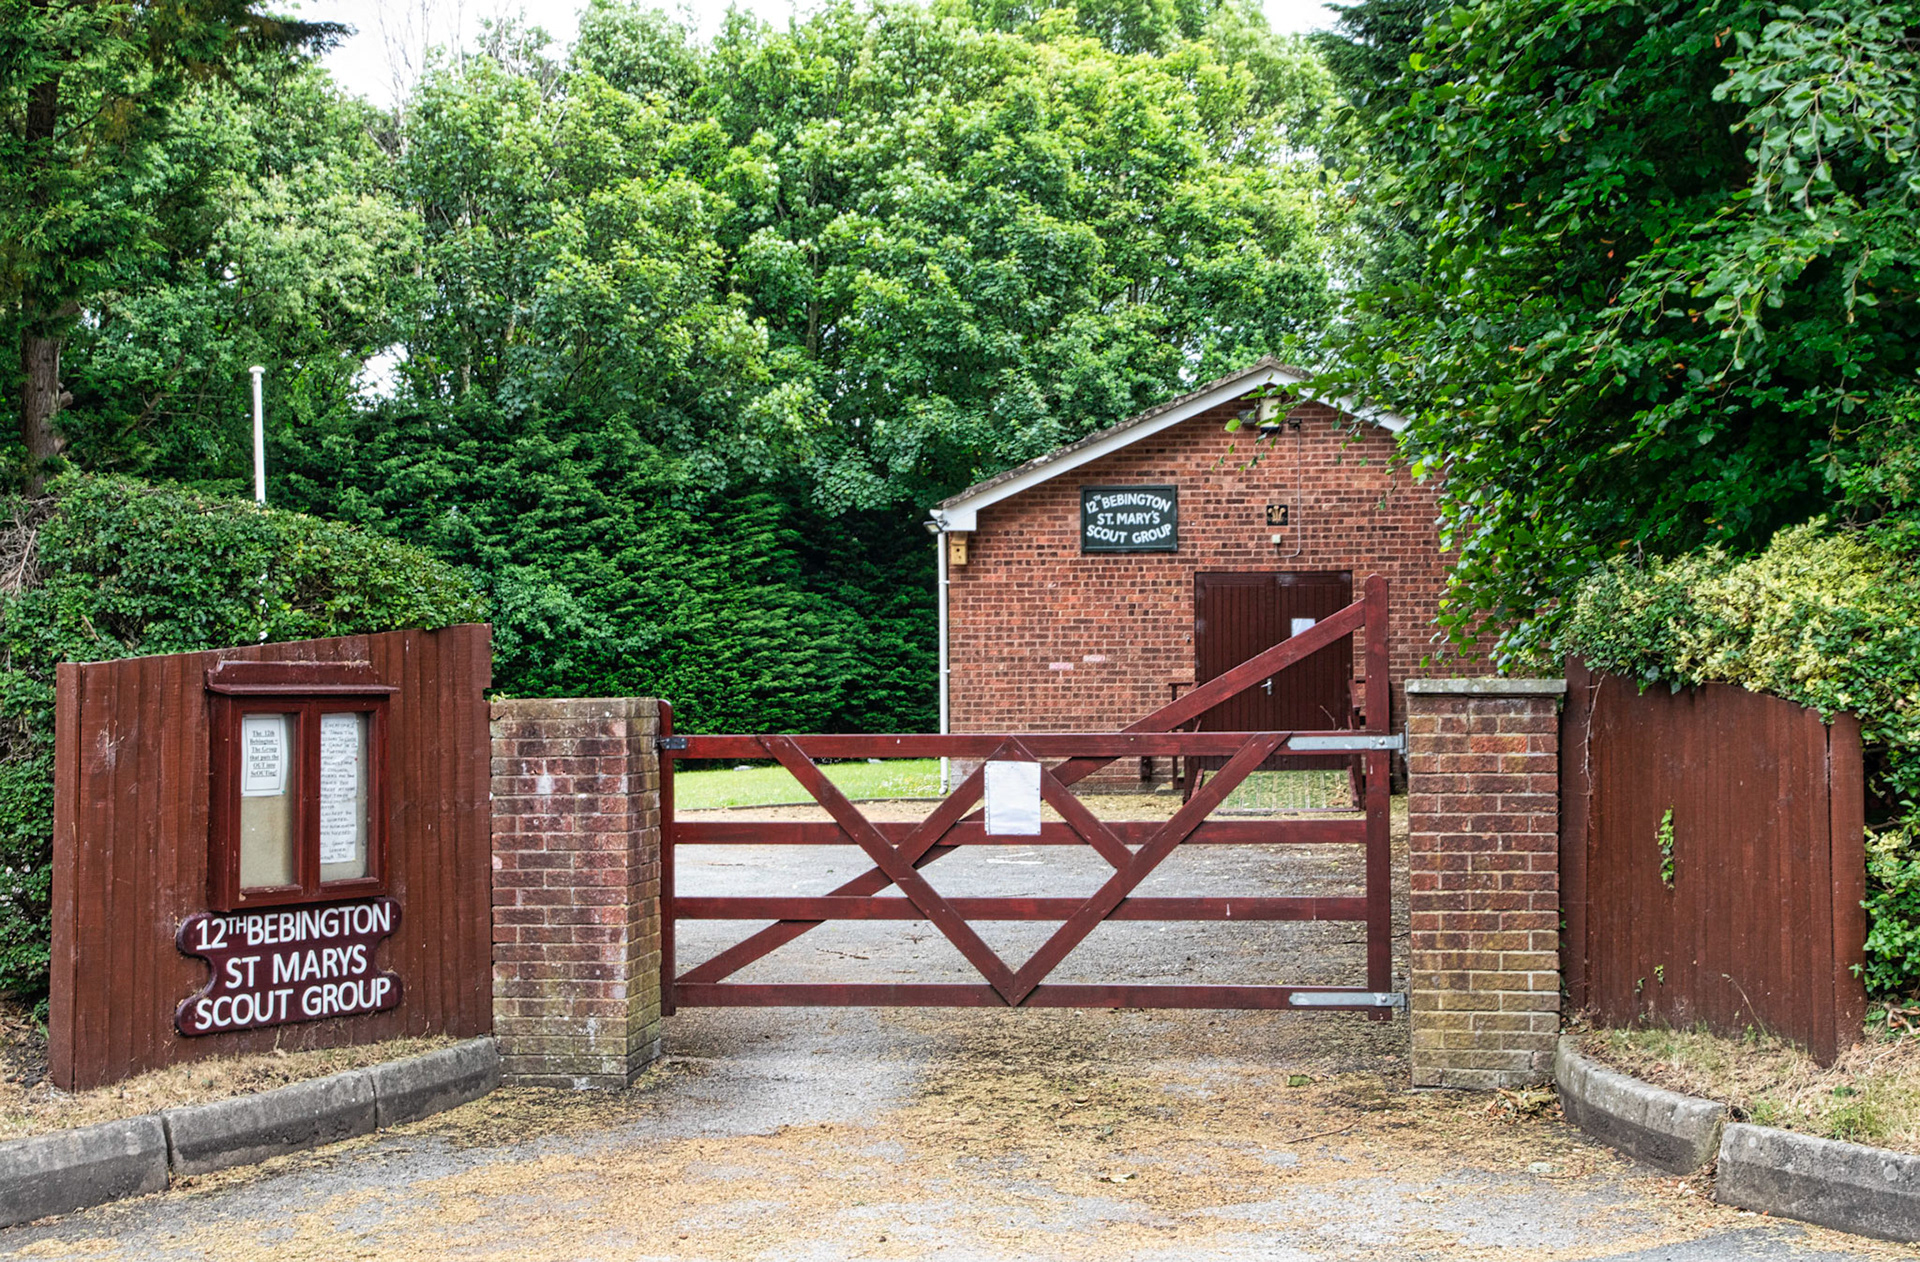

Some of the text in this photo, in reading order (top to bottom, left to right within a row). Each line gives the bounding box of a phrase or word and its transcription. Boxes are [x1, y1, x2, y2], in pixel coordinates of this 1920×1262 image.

[1097, 510, 1160, 525] ST. MARY'S
[1101, 493, 1172, 513] BEBINGTON
[1086, 523, 1172, 544] SCOUT GROUP
[246, 902, 391, 946] BEBINGTON
[225, 944, 367, 989] ST MARYS
[195, 977, 391, 1031] SCOUT GROUP
